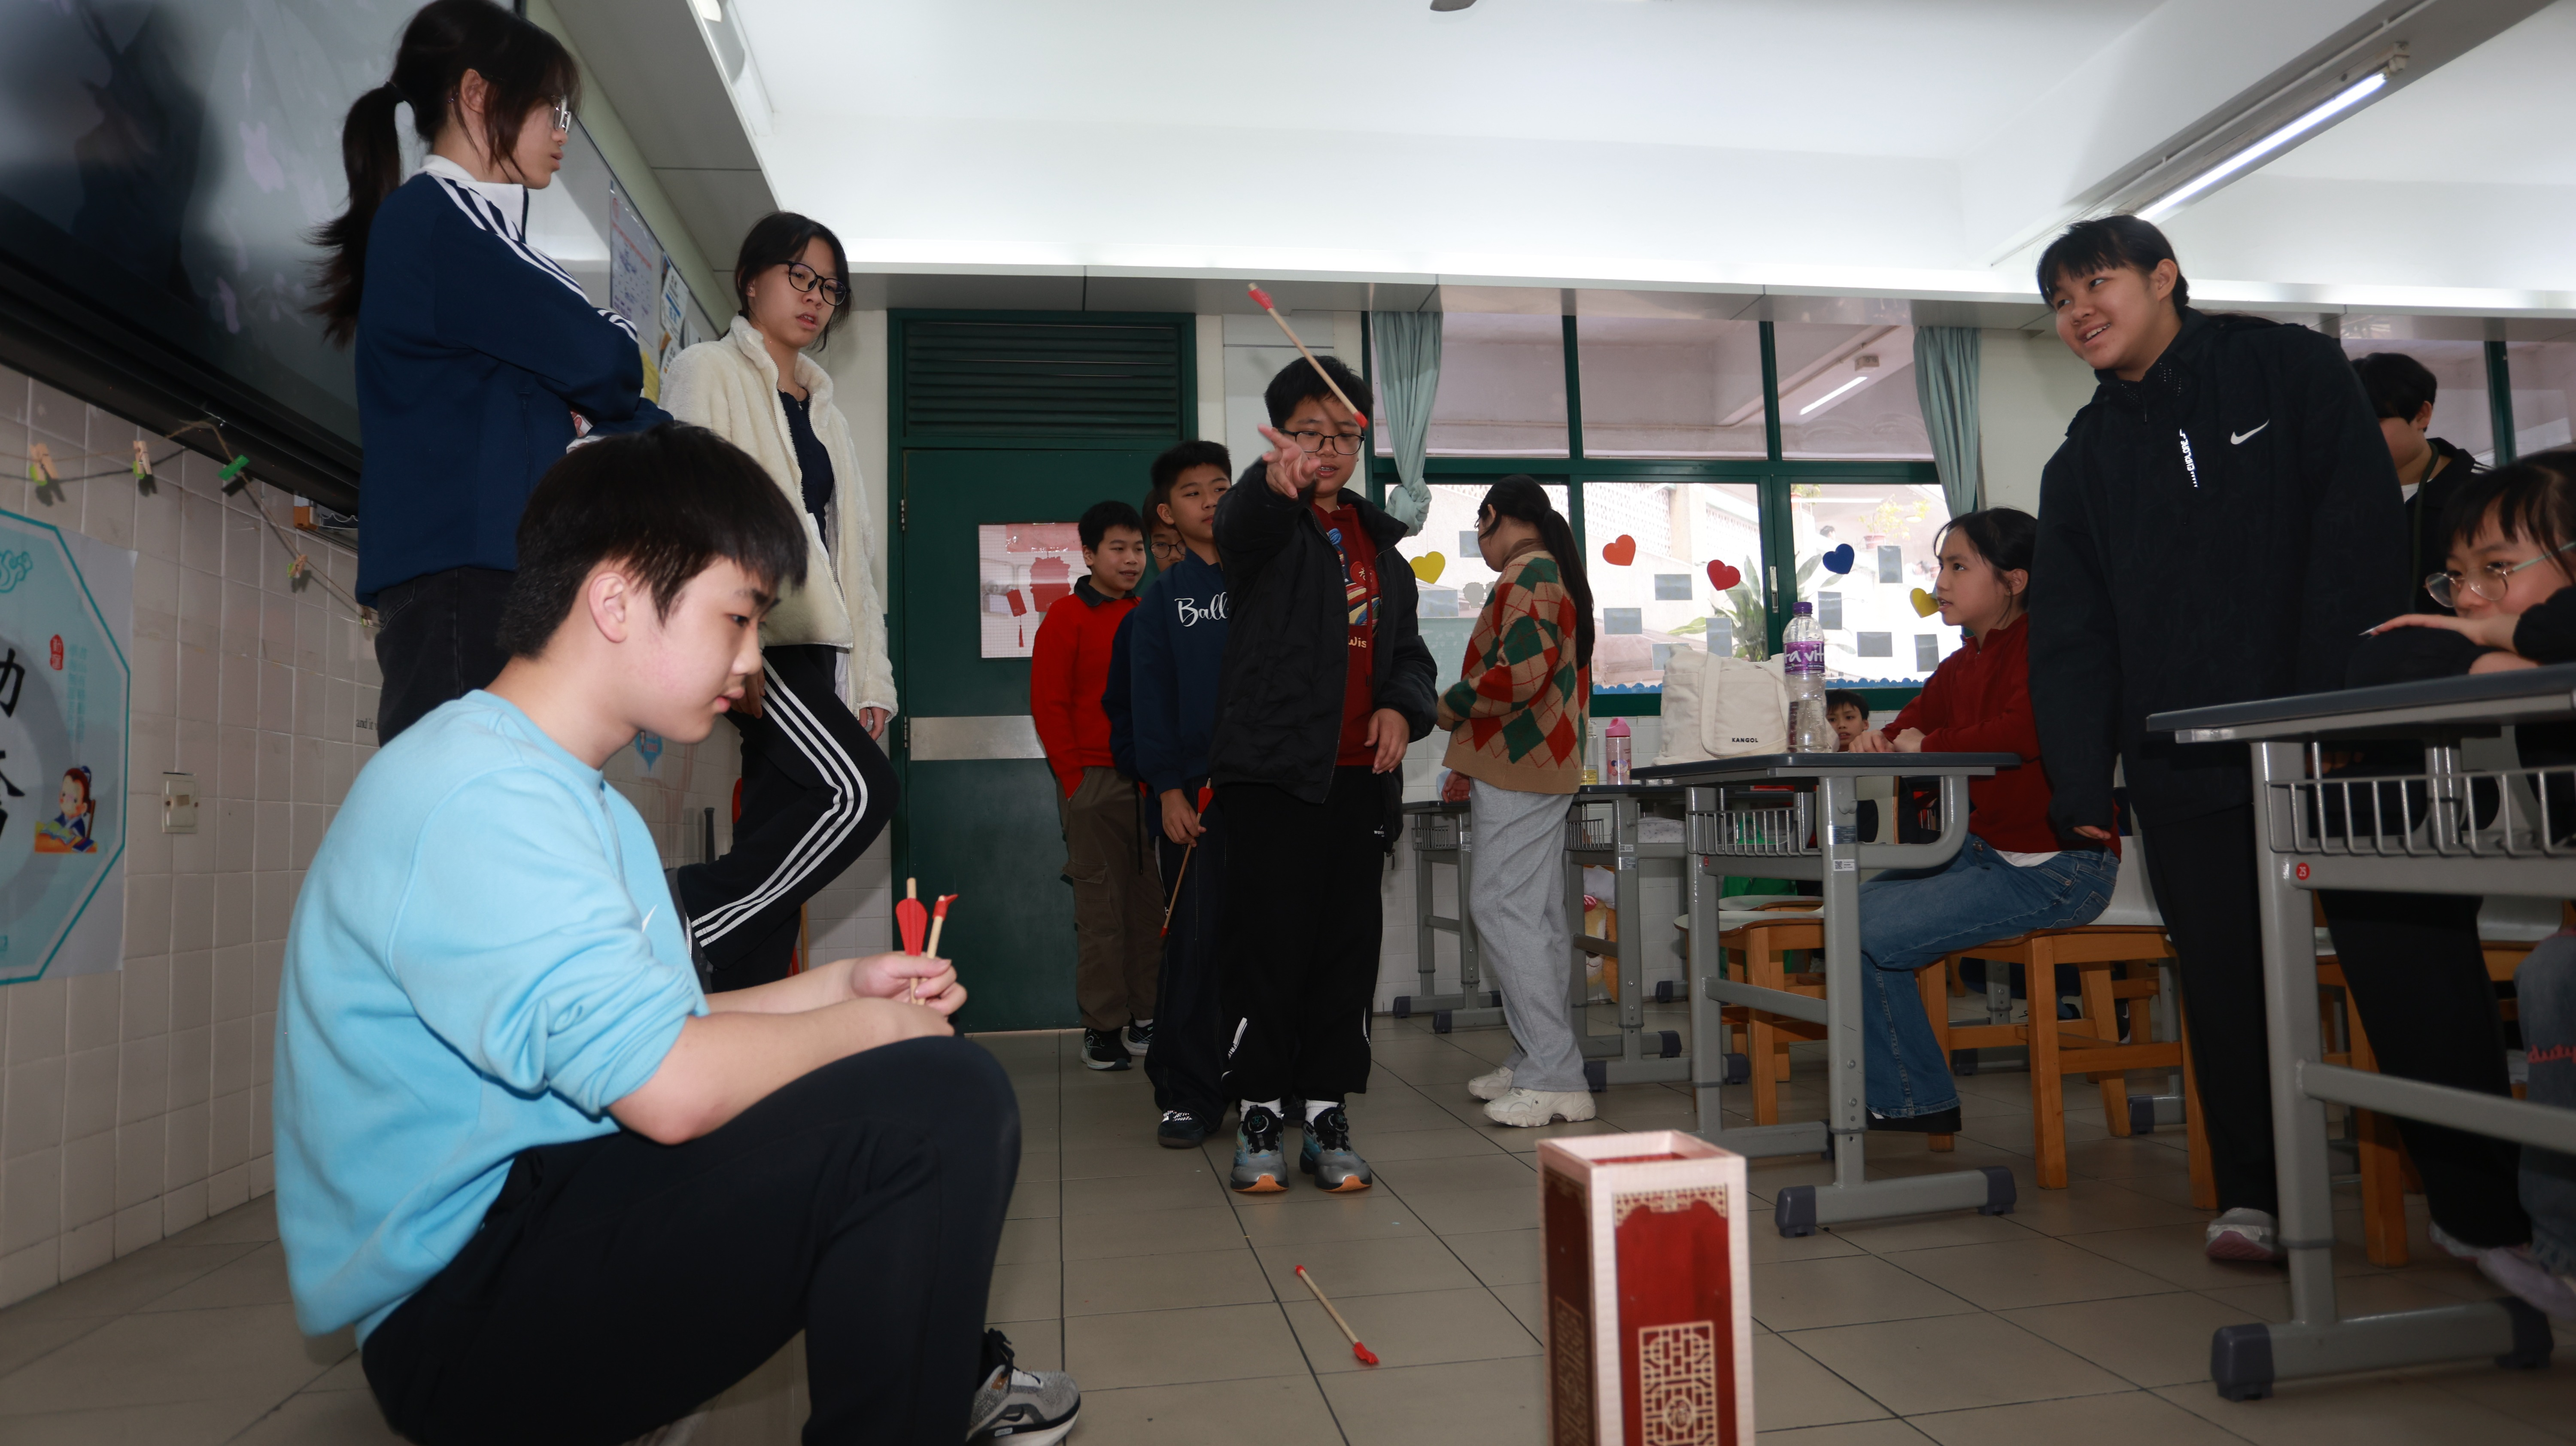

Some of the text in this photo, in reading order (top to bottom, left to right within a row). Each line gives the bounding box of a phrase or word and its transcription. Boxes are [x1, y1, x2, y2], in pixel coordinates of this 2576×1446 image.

[1174, 592, 1229, 627] Ball
[356, 718, 367, 729] and
[369, 718, 373, 730] it
[2299, 866, 2306, 876] 25
